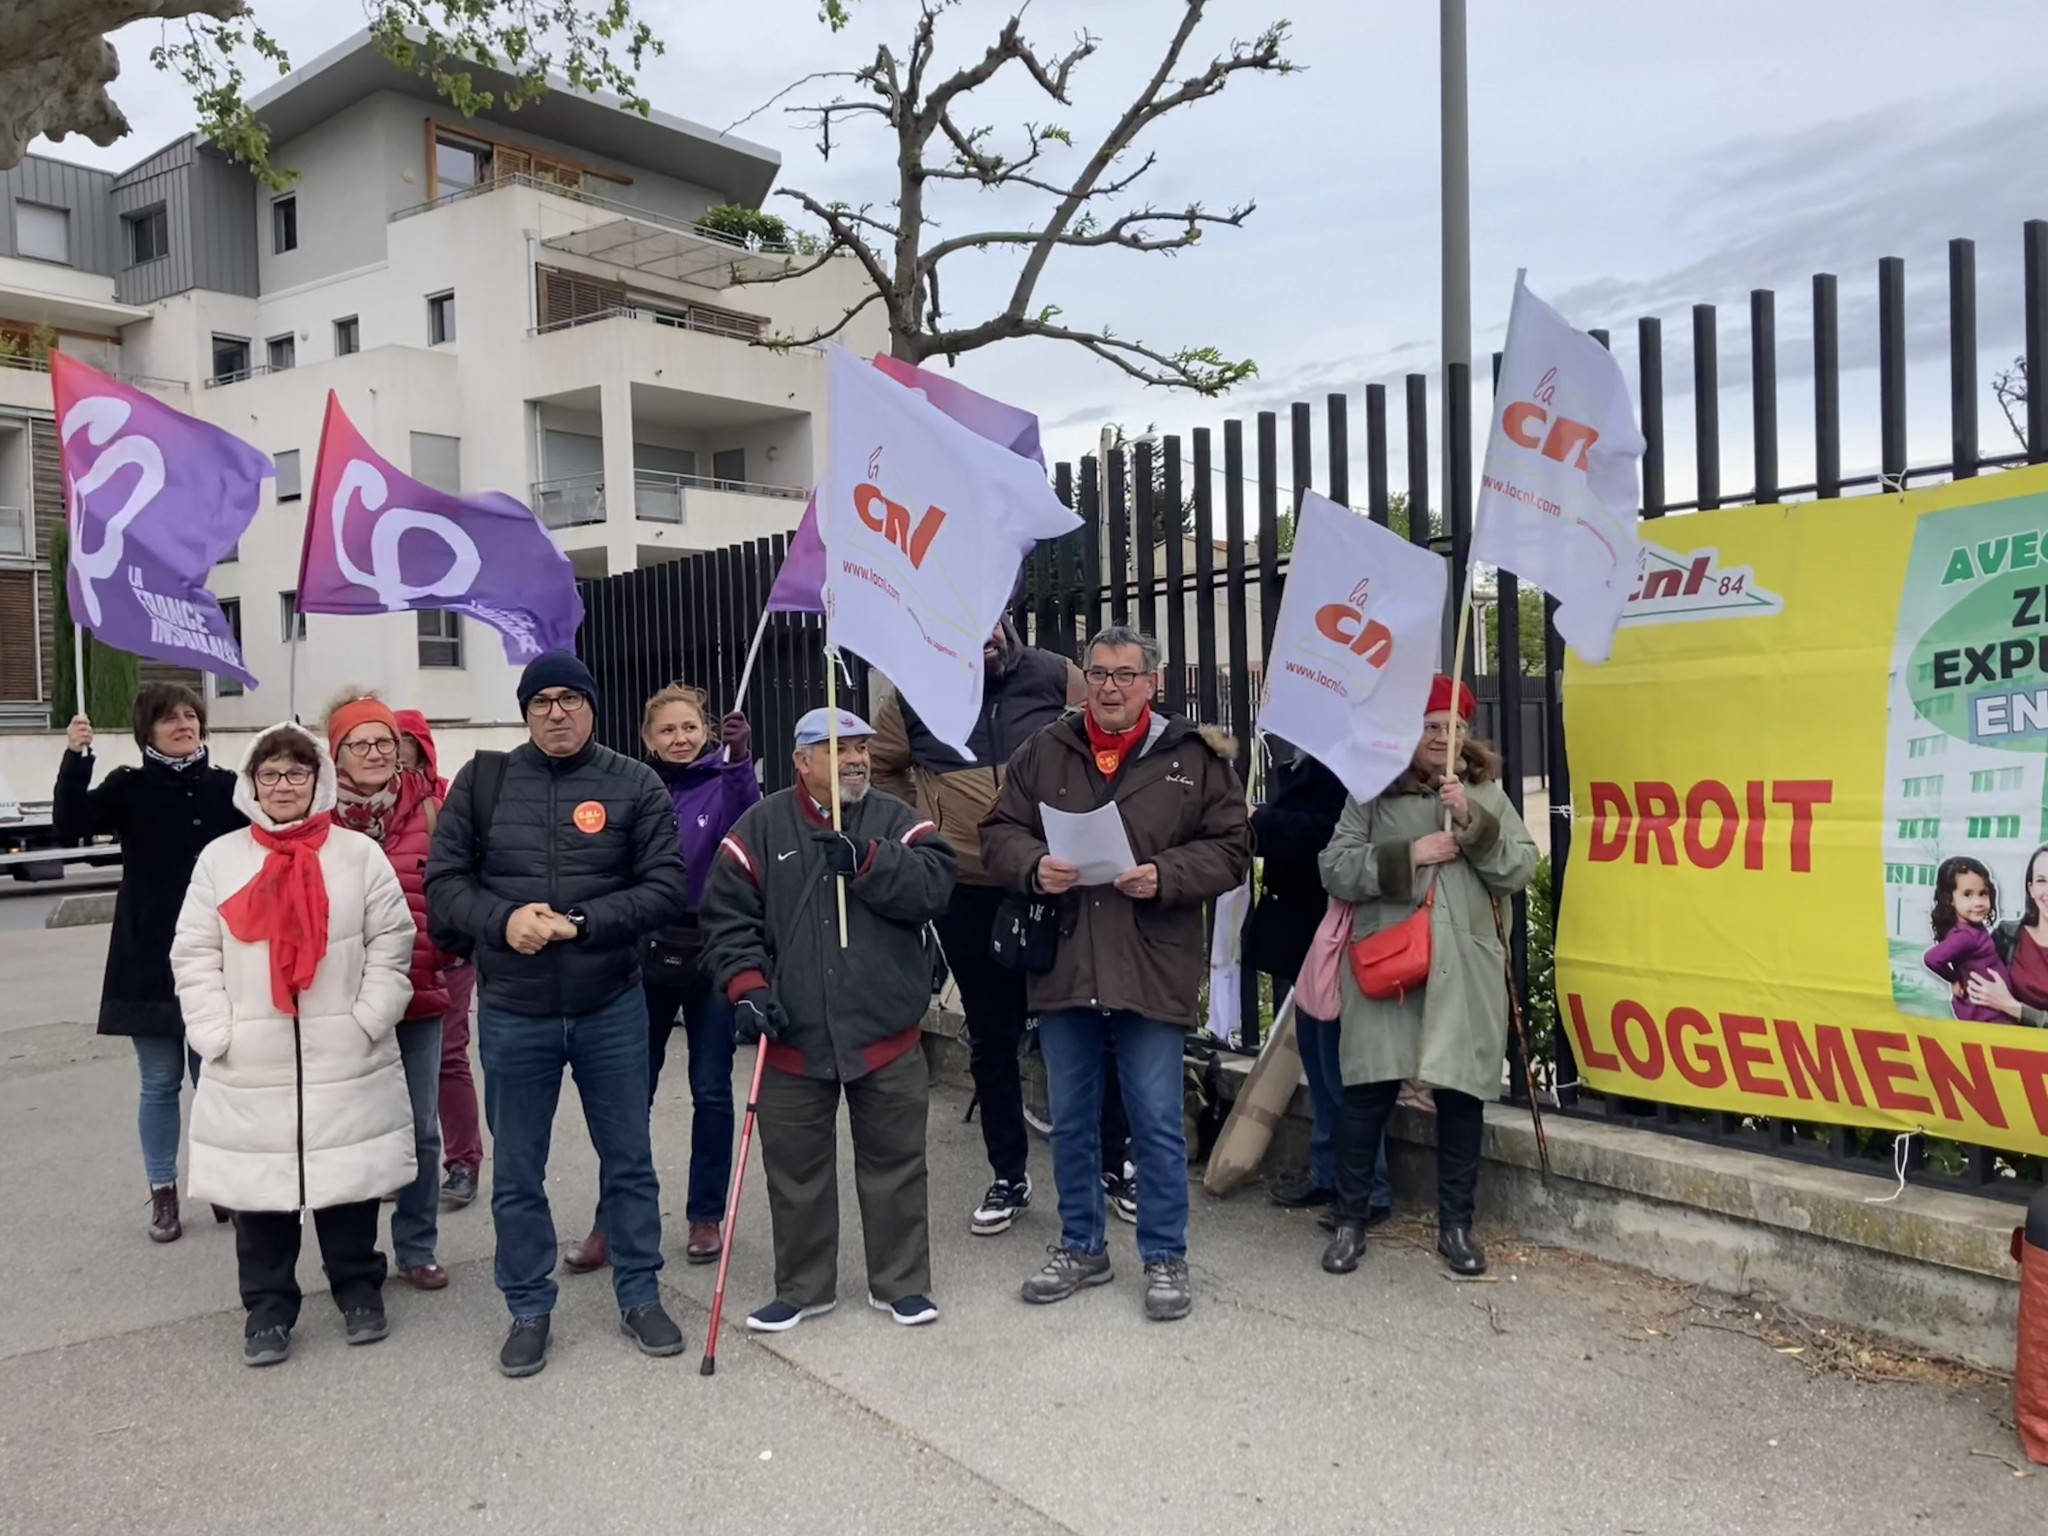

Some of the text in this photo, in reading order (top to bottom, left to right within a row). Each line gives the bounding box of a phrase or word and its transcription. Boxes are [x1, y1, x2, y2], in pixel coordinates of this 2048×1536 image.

[1483, 474, 1561, 517] ww.lacnl.com
[1718, 575, 1745, 596] 84
[2012, 584, 2048, 628] Z
[1588, 779, 1833, 873] DROIT
